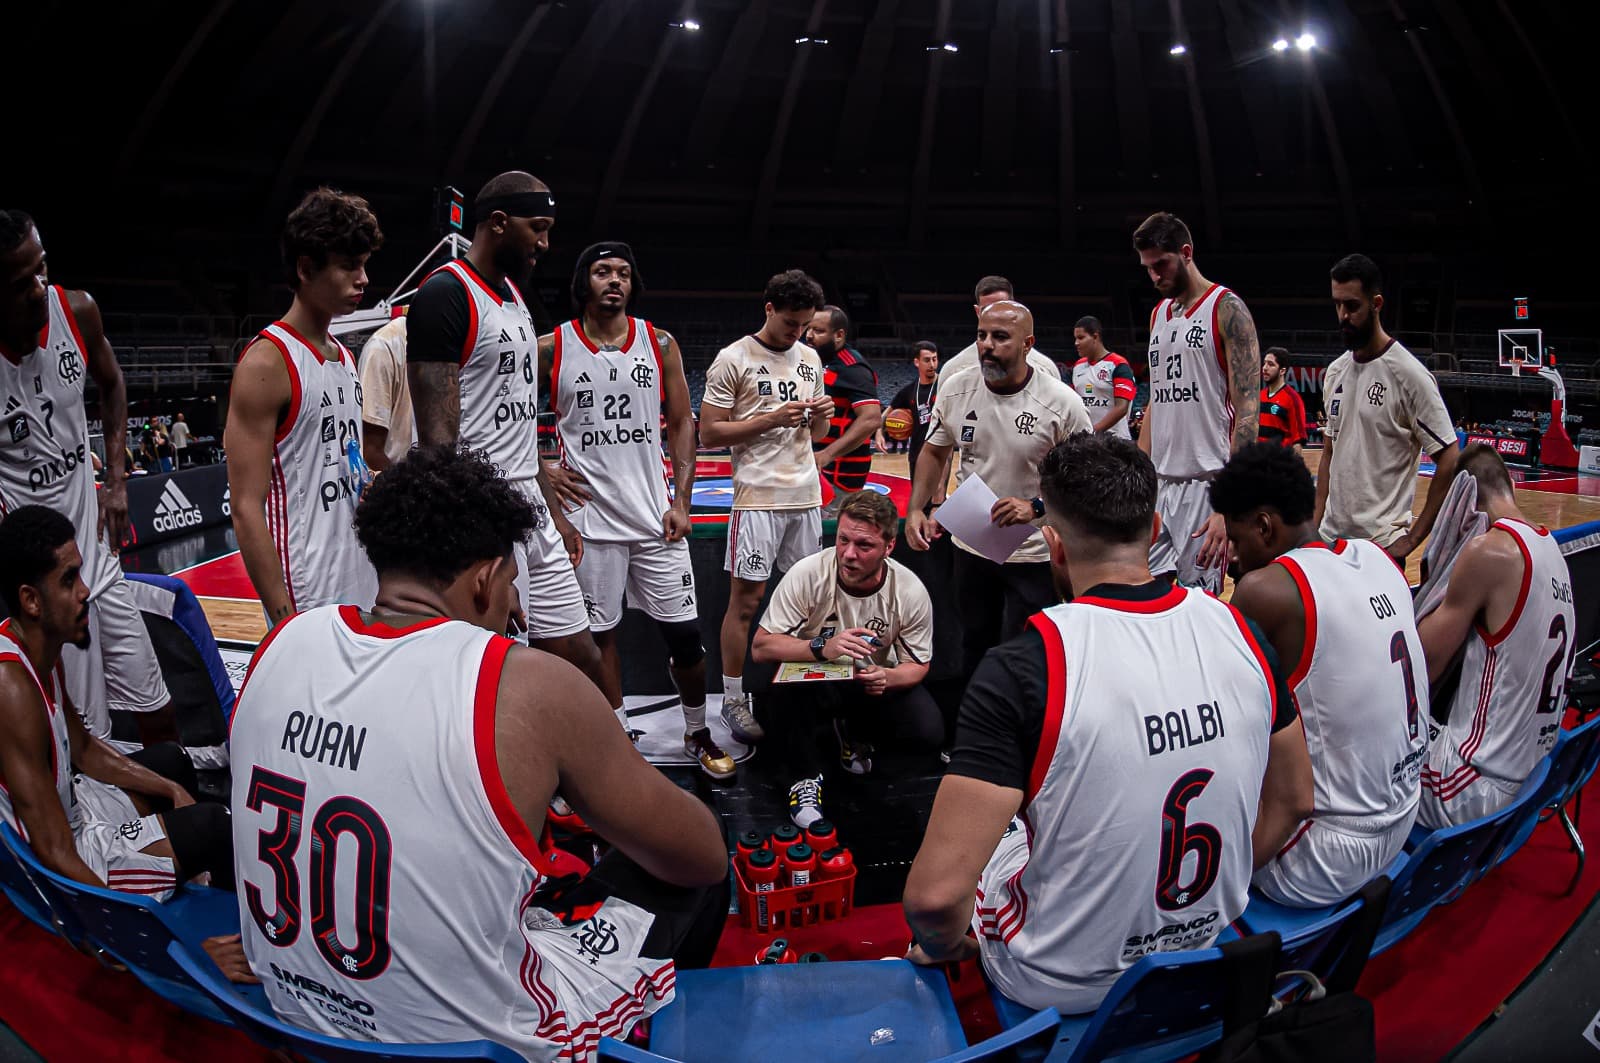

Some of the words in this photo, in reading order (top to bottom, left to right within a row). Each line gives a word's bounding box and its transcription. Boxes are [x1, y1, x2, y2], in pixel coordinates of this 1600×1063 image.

[523, 352, 534, 384] 8
[1166, 353, 1182, 380] 23
[604, 393, 632, 420] 22
[778, 381, 799, 401] 92
[40, 400, 54, 437] 7
[494, 394, 537, 430] pix.b
[581, 422, 652, 452] pix.bet
[1500, 441, 1525, 454] SESI
[153, 508, 203, 533] adidas
[1369, 593, 1397, 620] GUI
[1389, 630, 1419, 741] 1
[280, 710, 367, 772] RUAN
[1144, 700, 1225, 756] BALBI
[1155, 768, 1222, 911] 6
[244, 764, 392, 980] 30
[1123, 945, 1157, 956] FAN
[1162, 926, 1214, 945] TOKEN
[277, 981, 309, 1002] FAN
[314, 997, 377, 1031] TOKEN
